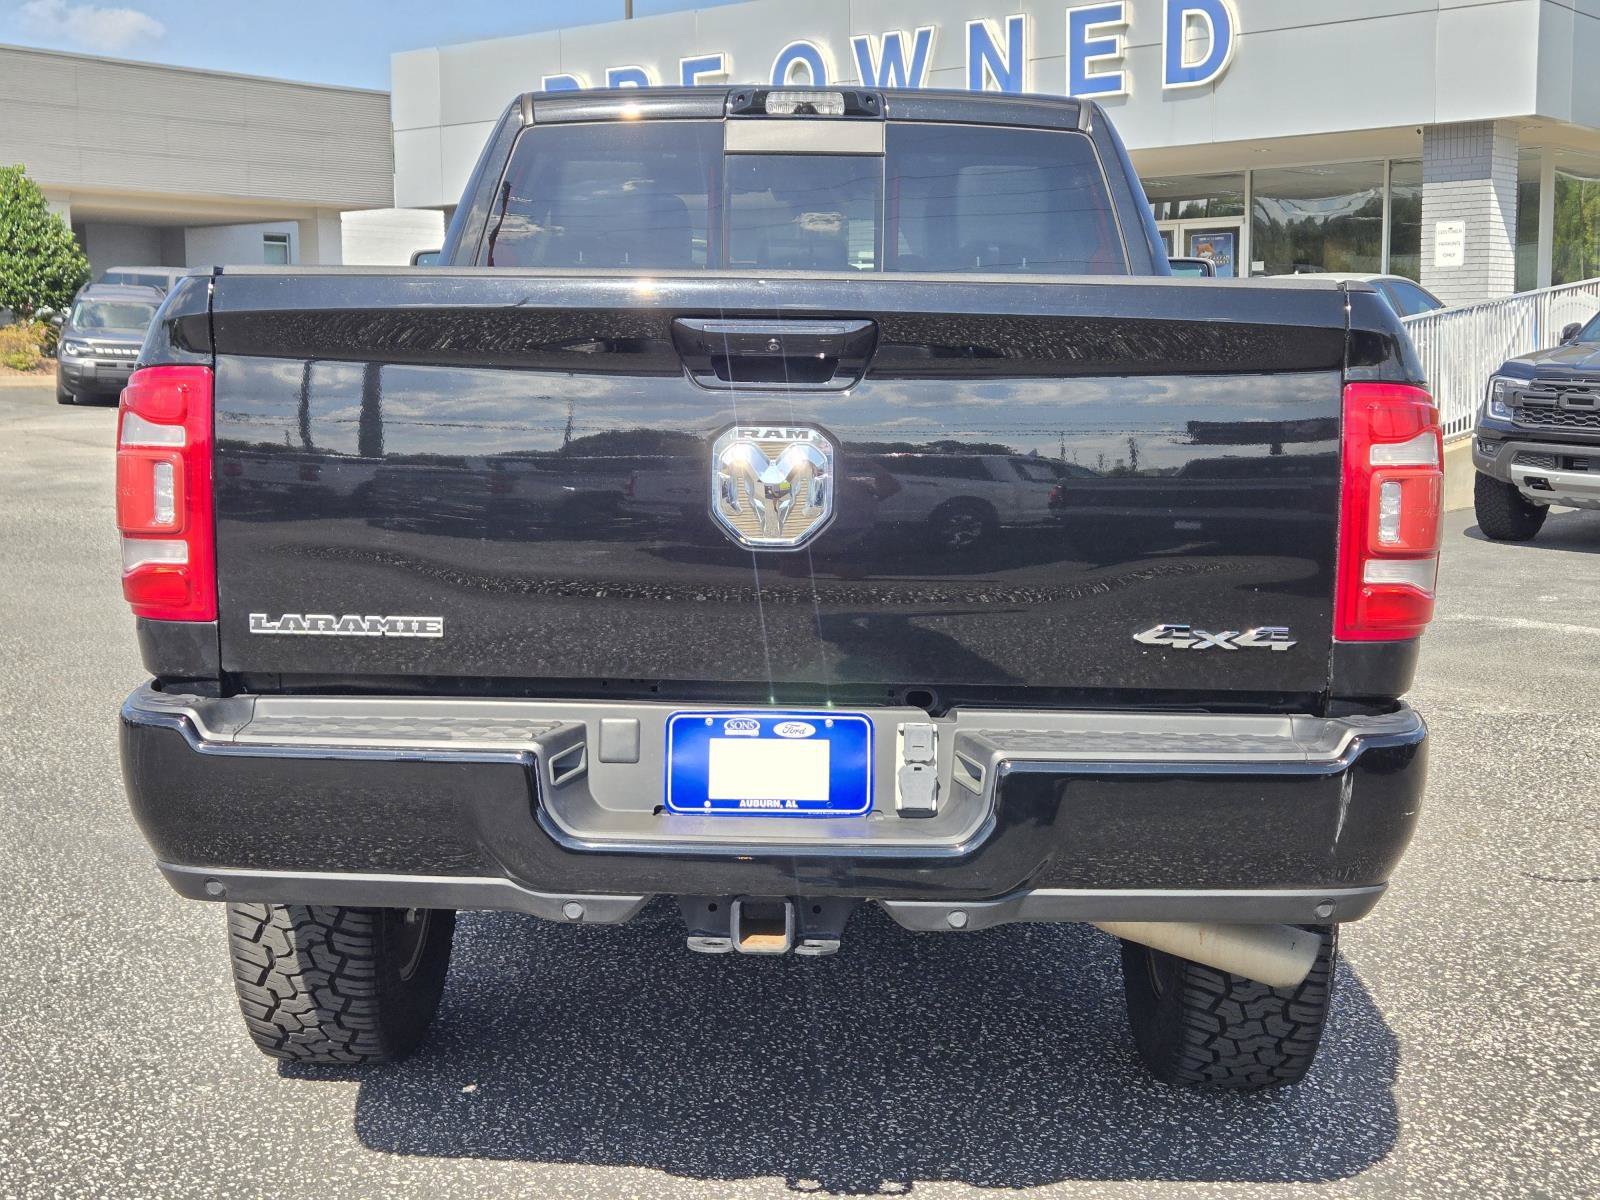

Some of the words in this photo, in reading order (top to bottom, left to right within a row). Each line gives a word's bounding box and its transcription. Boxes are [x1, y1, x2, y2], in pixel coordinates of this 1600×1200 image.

[769, 0, 1236, 97] OWNED
[737, 429, 809, 440] RAM
[249, 613, 443, 637] LARAMIE
[728, 719, 756, 730] SONS
[782, 723, 807, 735] Ford
[739, 799, 784, 809] AUBURN,
[785, 800, 798, 809] AL
